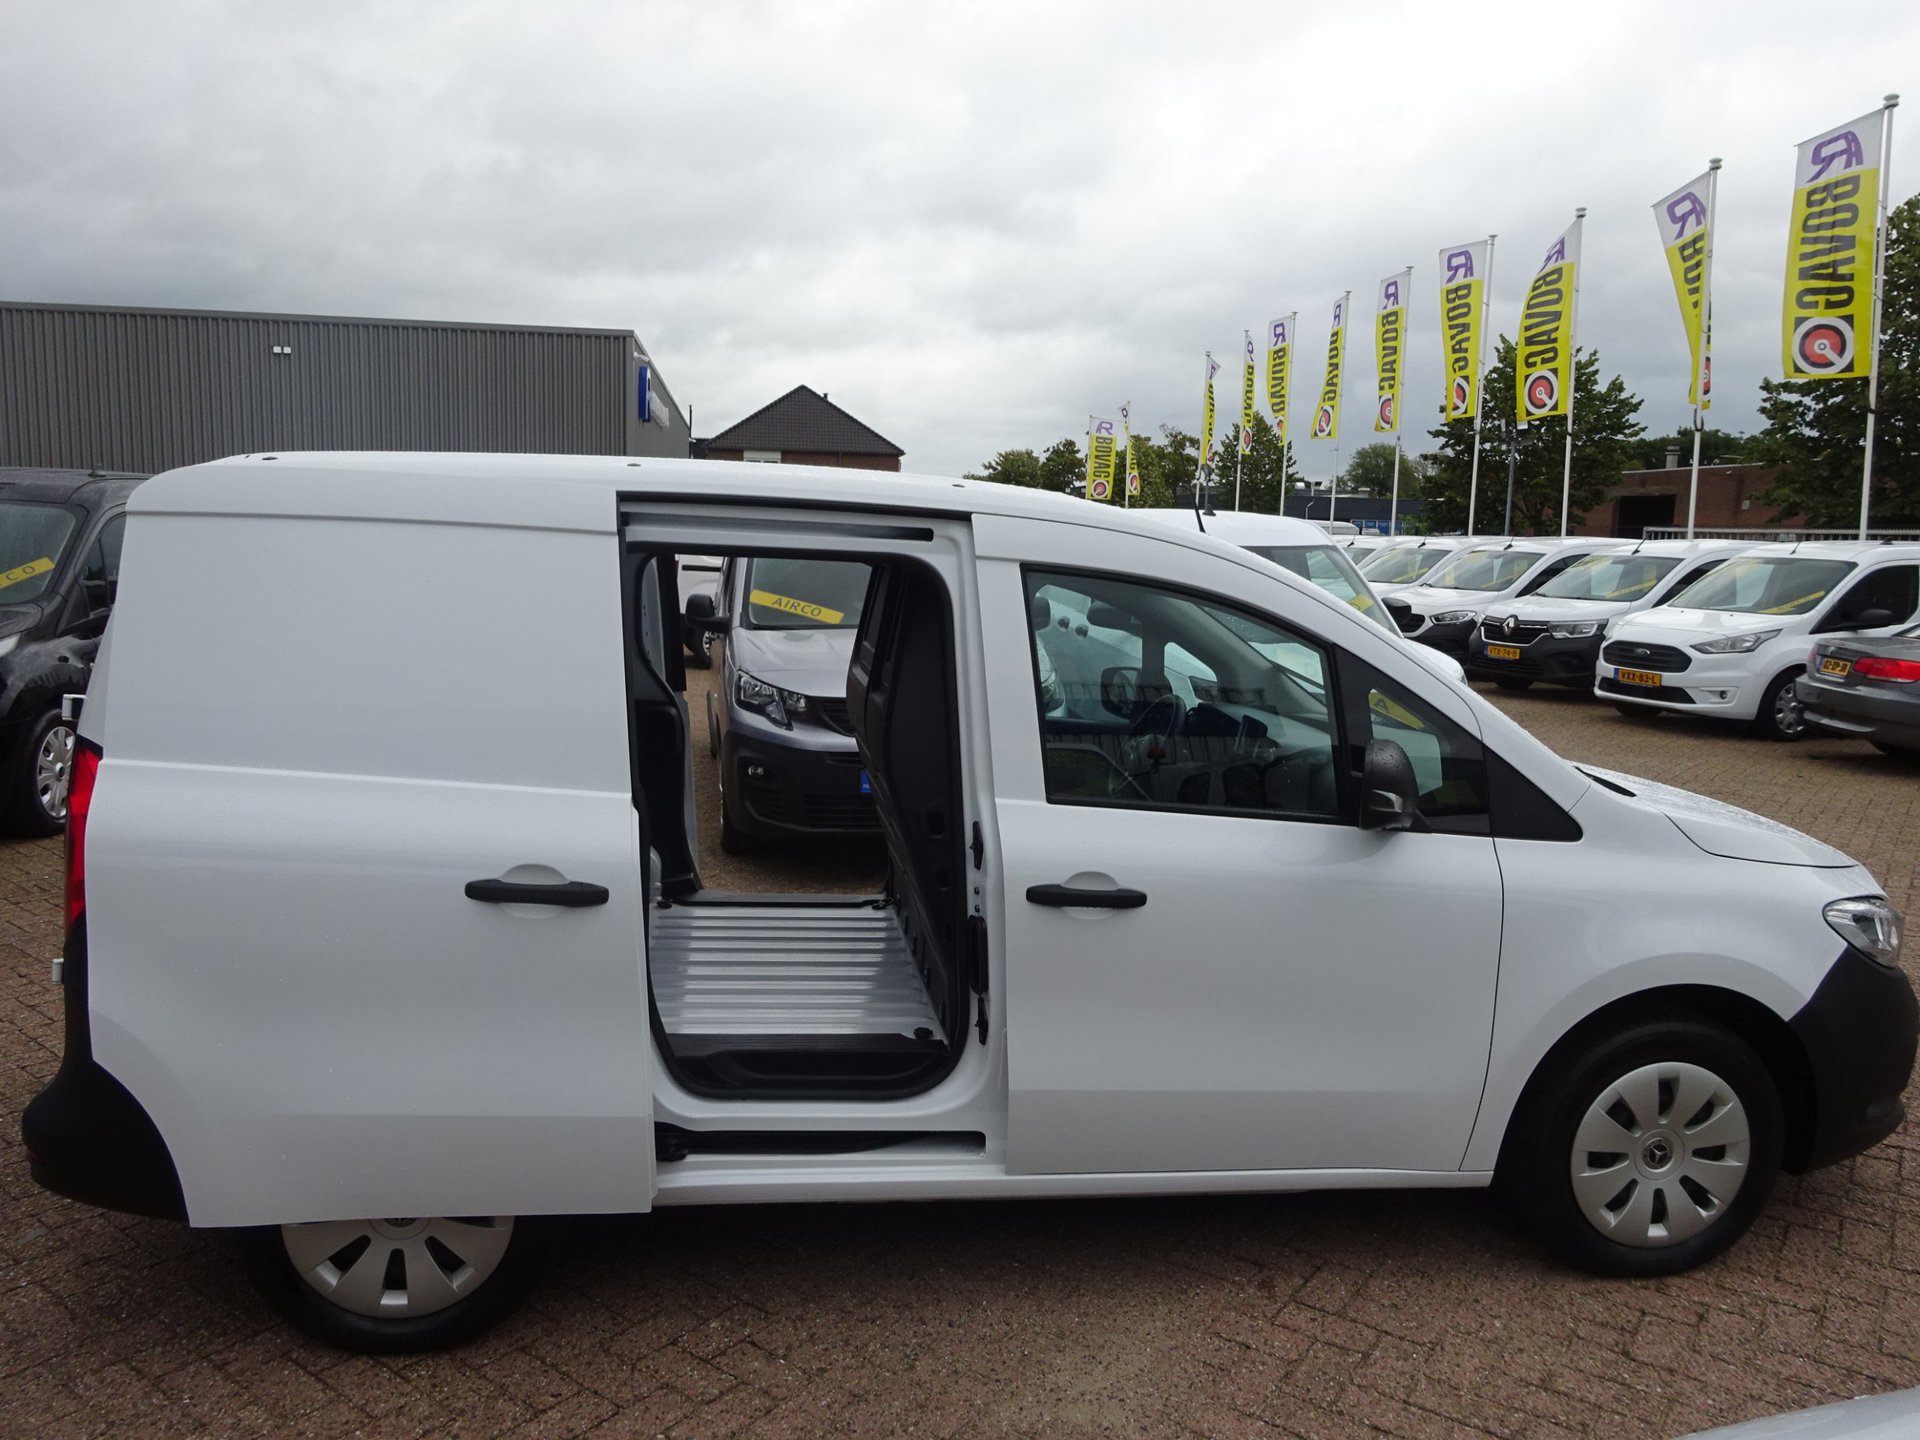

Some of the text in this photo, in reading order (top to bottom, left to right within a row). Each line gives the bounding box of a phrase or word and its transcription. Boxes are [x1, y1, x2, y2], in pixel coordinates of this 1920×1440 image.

[1093, 435, 1114, 479] BOVAG
[771, 597, 822, 617] AIRCO
[1621, 670, 1657, 685] VXX-83-L
